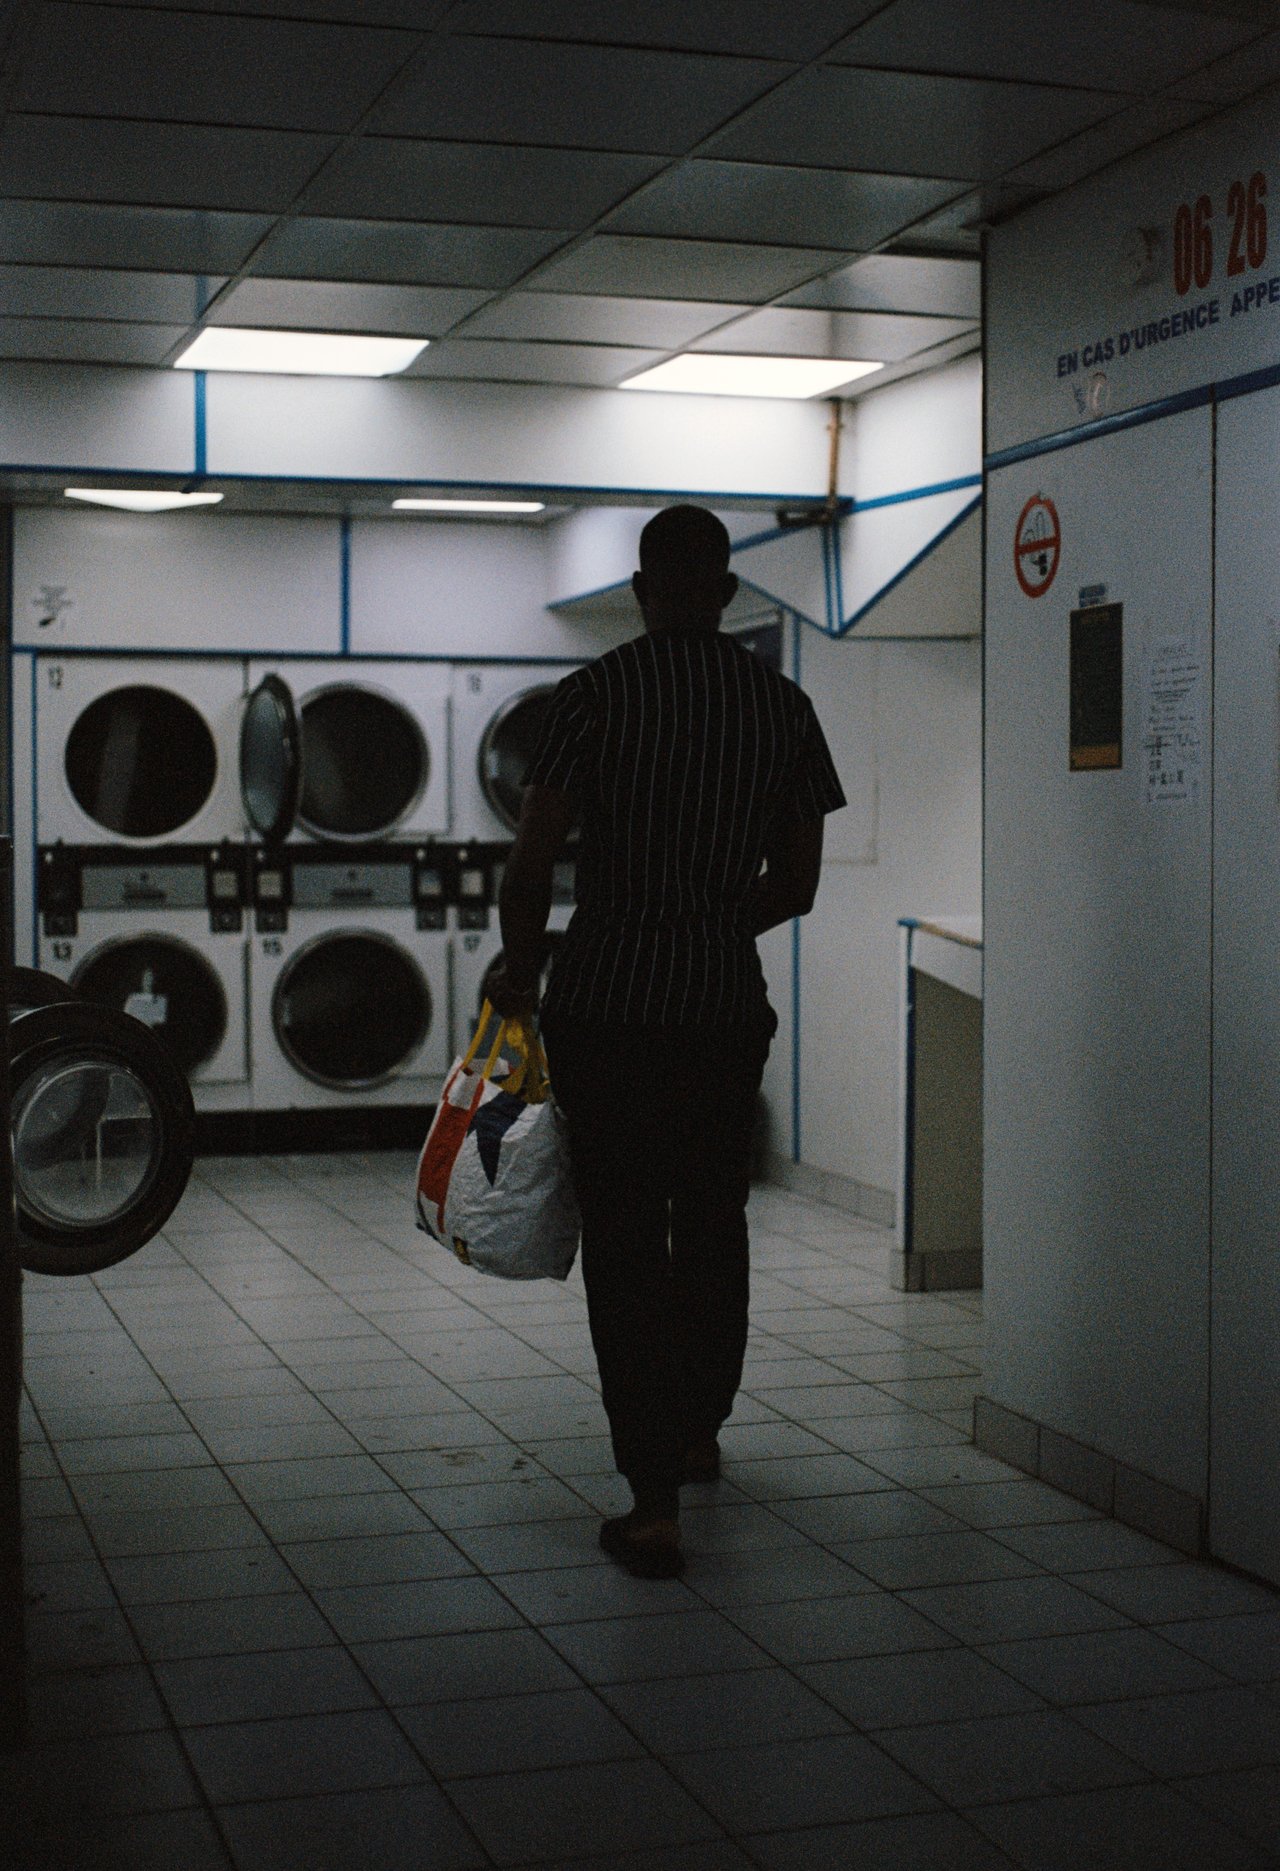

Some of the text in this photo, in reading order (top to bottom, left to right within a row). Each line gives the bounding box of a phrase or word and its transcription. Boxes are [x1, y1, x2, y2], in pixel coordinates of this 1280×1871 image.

[1174, 171, 1267, 295] 06 26
[1057, 277, 1280, 378] EN CAS D'URGENCE APPE
